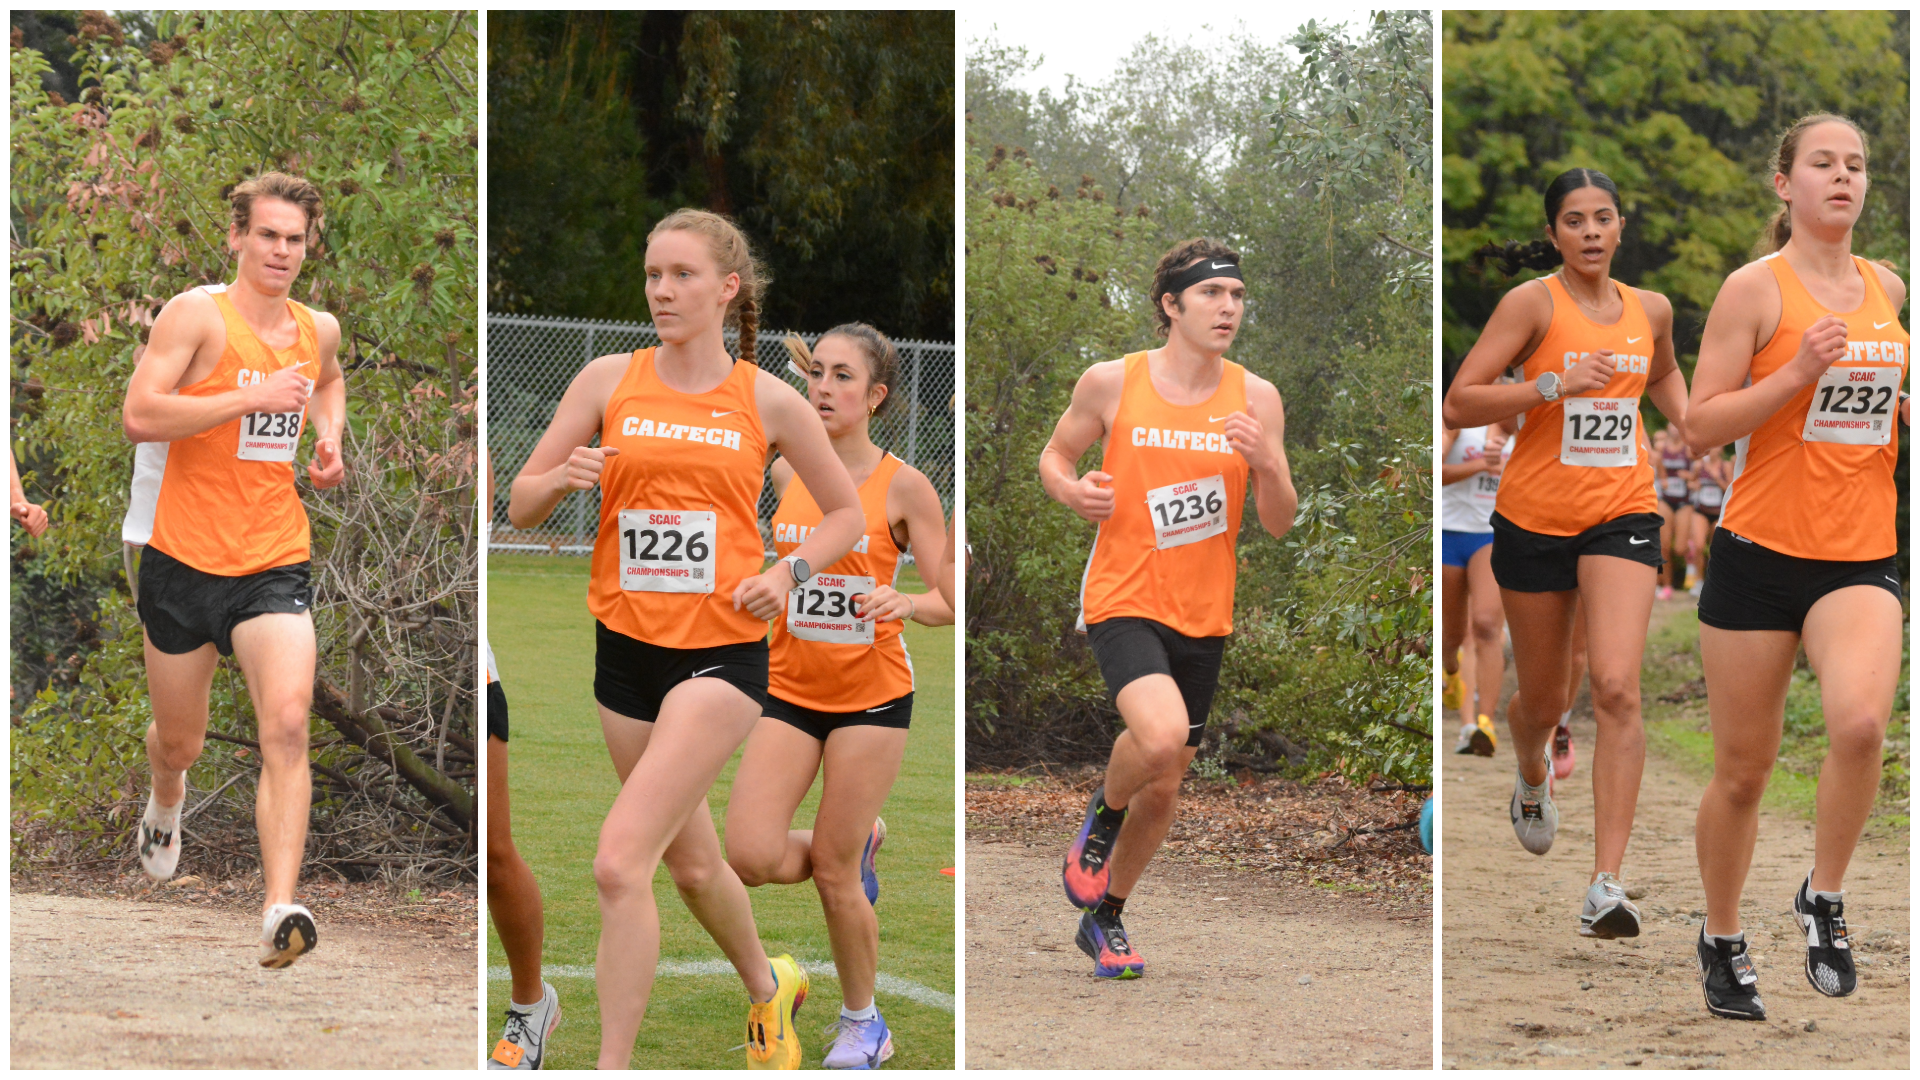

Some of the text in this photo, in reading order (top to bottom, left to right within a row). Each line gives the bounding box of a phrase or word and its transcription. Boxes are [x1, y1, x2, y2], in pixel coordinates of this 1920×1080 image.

[1834, 341, 1905, 363] LTECH
[1563, 351, 1648, 375] CECH
[1848, 372, 1876, 381] SCAIC
[1593, 401, 1619, 411] SCAIC
[1819, 386, 1892, 414] 1232
[246, 412, 300, 437] 1238
[1569, 414, 1632, 440] 1229
[1813, 419, 1870, 429] CHAMPIONSHIPS
[622, 416, 741, 451] CALTECH
[245, 441, 288, 450] CHAMPIONSHIPS
[1569, 446, 1620, 454] CHAMPIONSHIPS
[1173, 483, 1198, 496] SCAIC
[1154, 490, 1222, 527] 1236
[649, 514, 681, 525] SCAIC
[1162, 521, 1211, 538] CHAMPIONSHIPS
[623, 529, 709, 562] 1226
[627, 567, 689, 577] CHAMPIONSHIPS
[817, 577, 846, 588] SCAIC
[794, 620, 852, 631] CHAMPIONSHIPS
